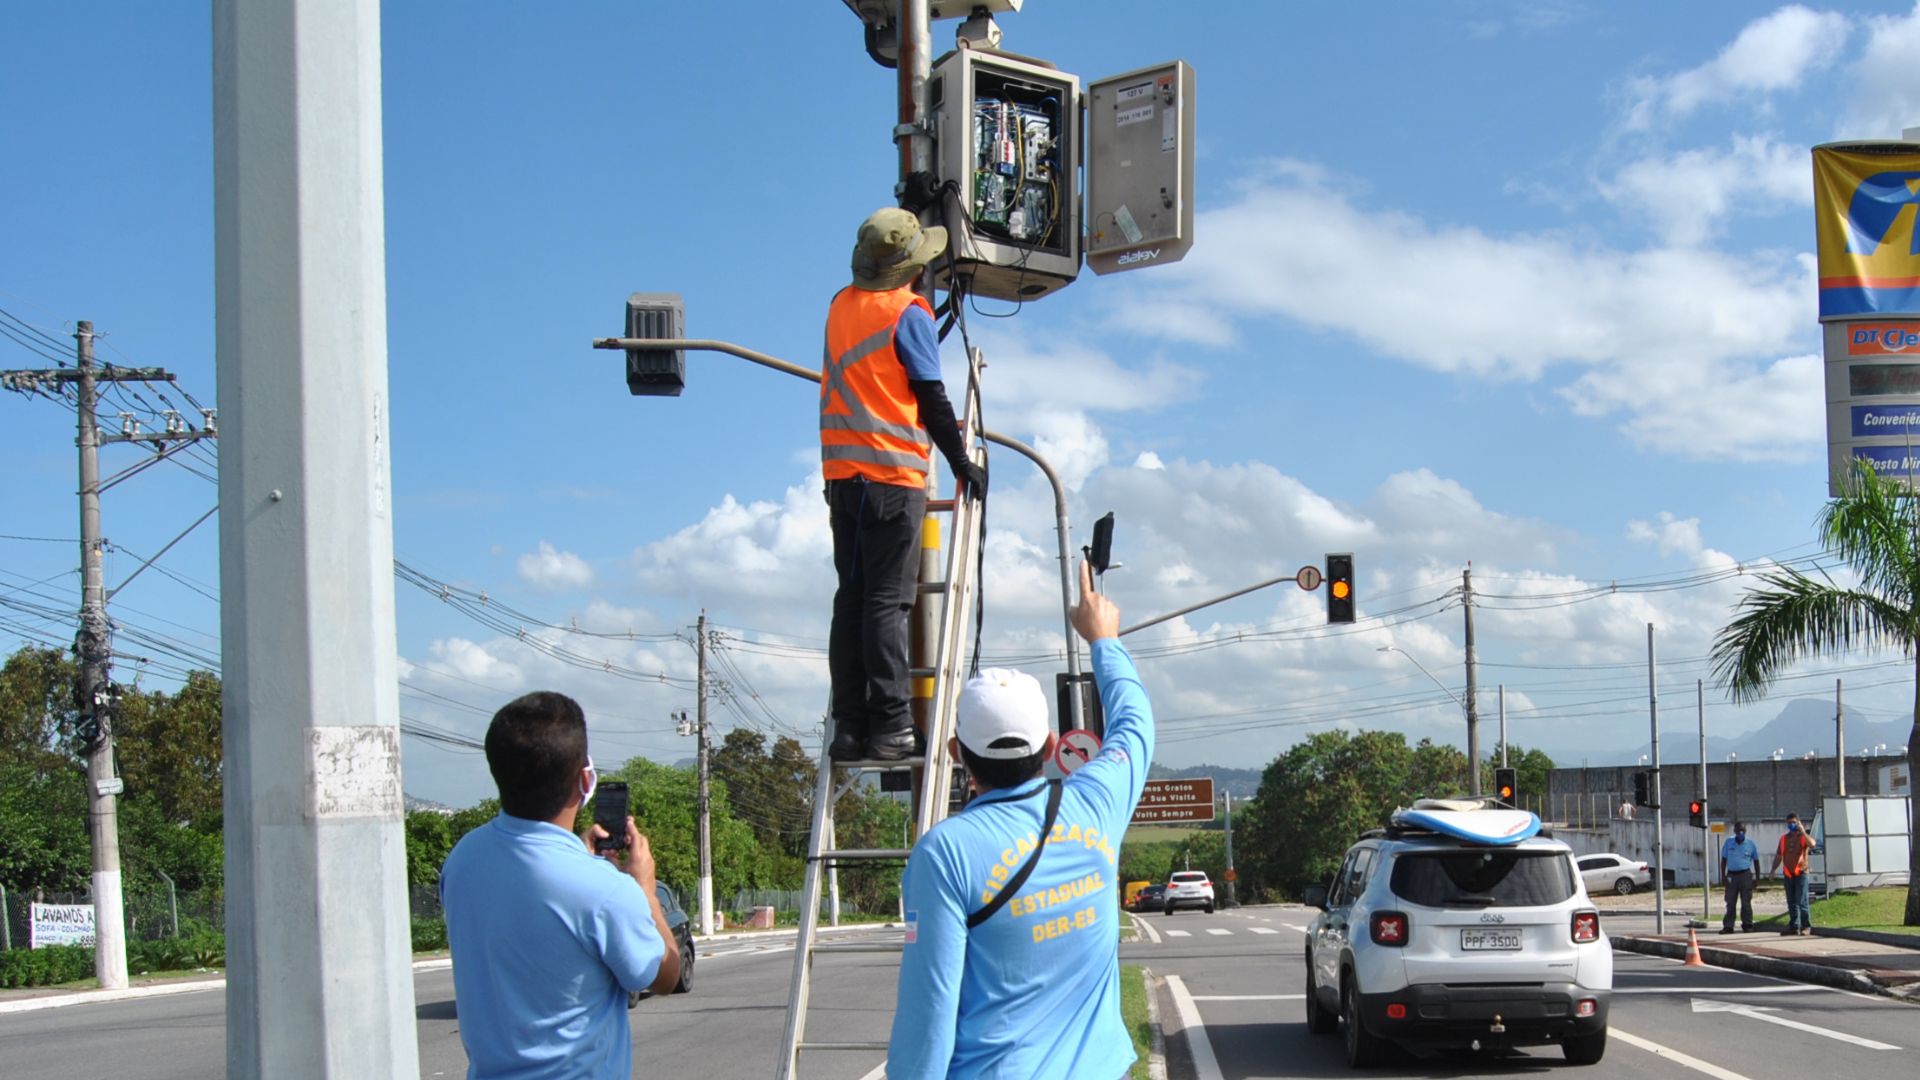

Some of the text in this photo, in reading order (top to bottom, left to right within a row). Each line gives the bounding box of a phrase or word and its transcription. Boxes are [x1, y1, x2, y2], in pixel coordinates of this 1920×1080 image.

[1853, 329, 1879, 344] DT
[1161, 810, 1194, 818] Sempre
[1010, 872, 1104, 917] ESTADUAL
[34, 906, 84, 923] LAVAMOS
[1480, 913, 1505, 923] Jeep
[1032, 907, 1096, 943] DER-ES
[1464, 936, 1519, 947] PPF-3500
